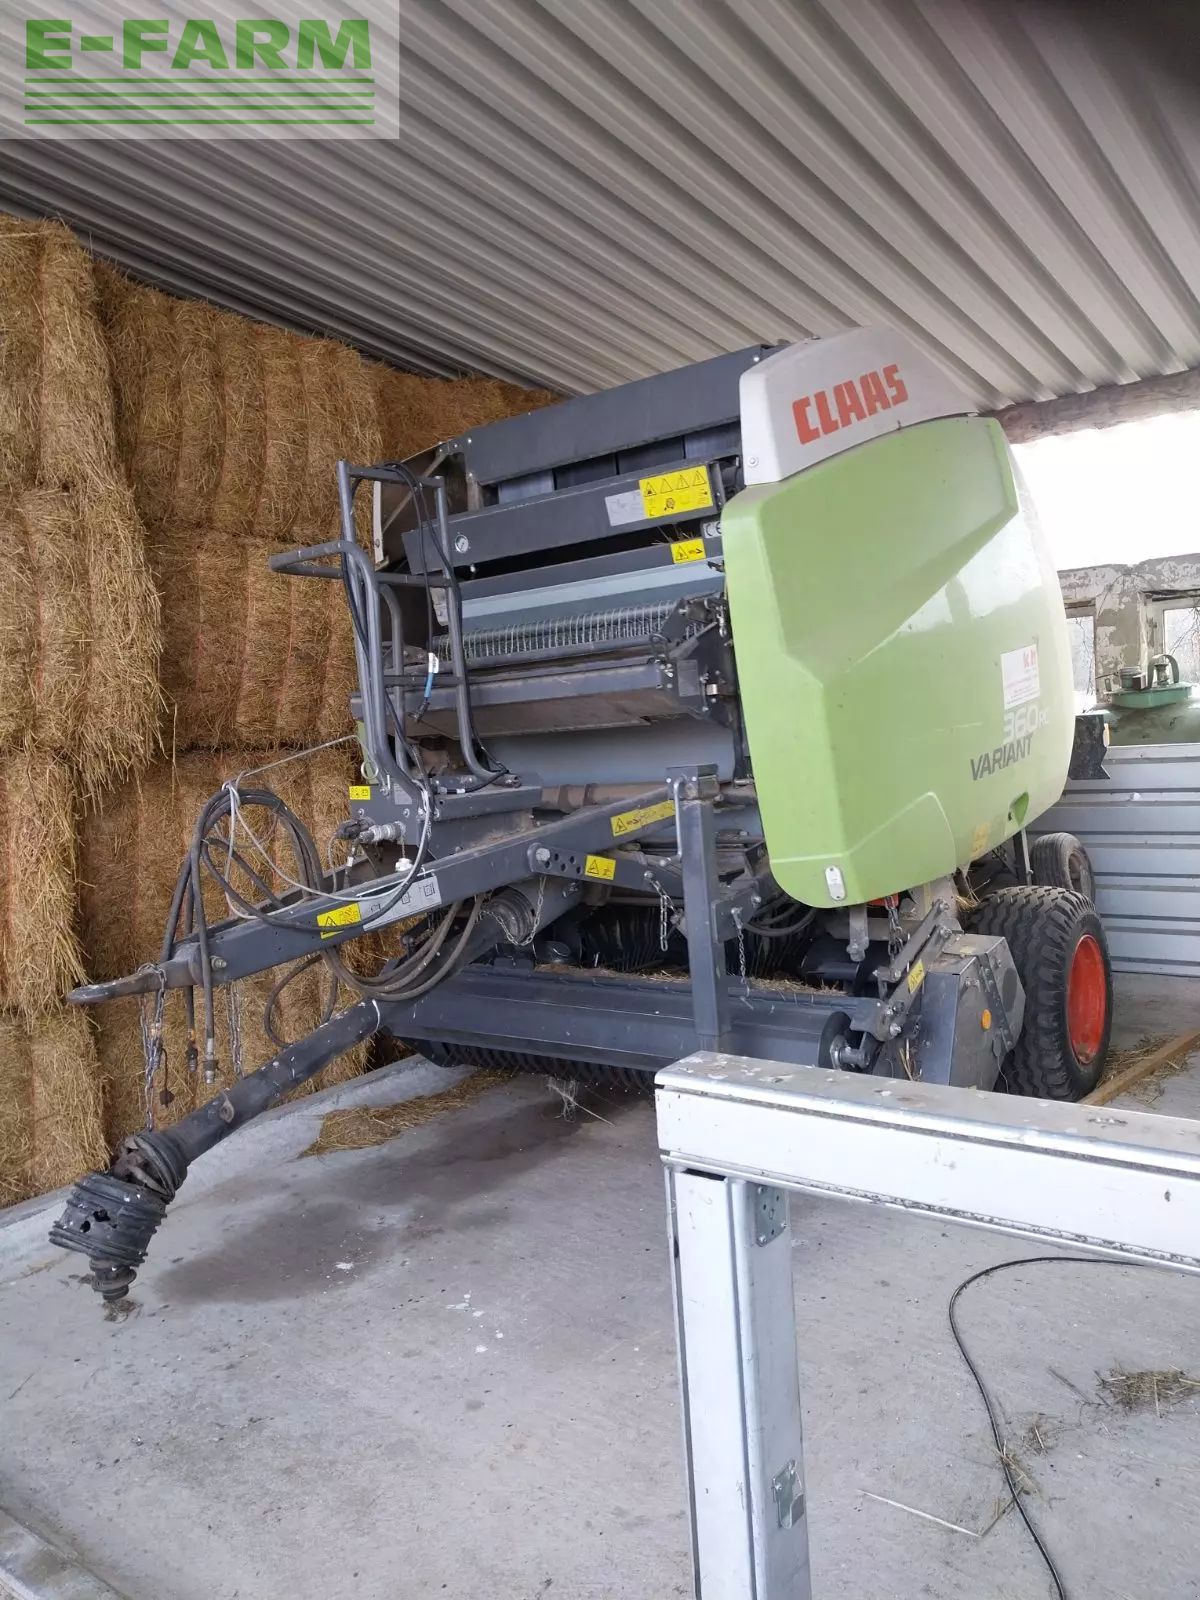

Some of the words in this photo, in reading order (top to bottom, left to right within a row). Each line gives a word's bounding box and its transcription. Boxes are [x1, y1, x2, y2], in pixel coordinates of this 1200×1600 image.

[792, 363, 909, 445] CLAAS
[1002, 704, 1039, 745] 360
[969, 732, 1034, 781] VARIANT
